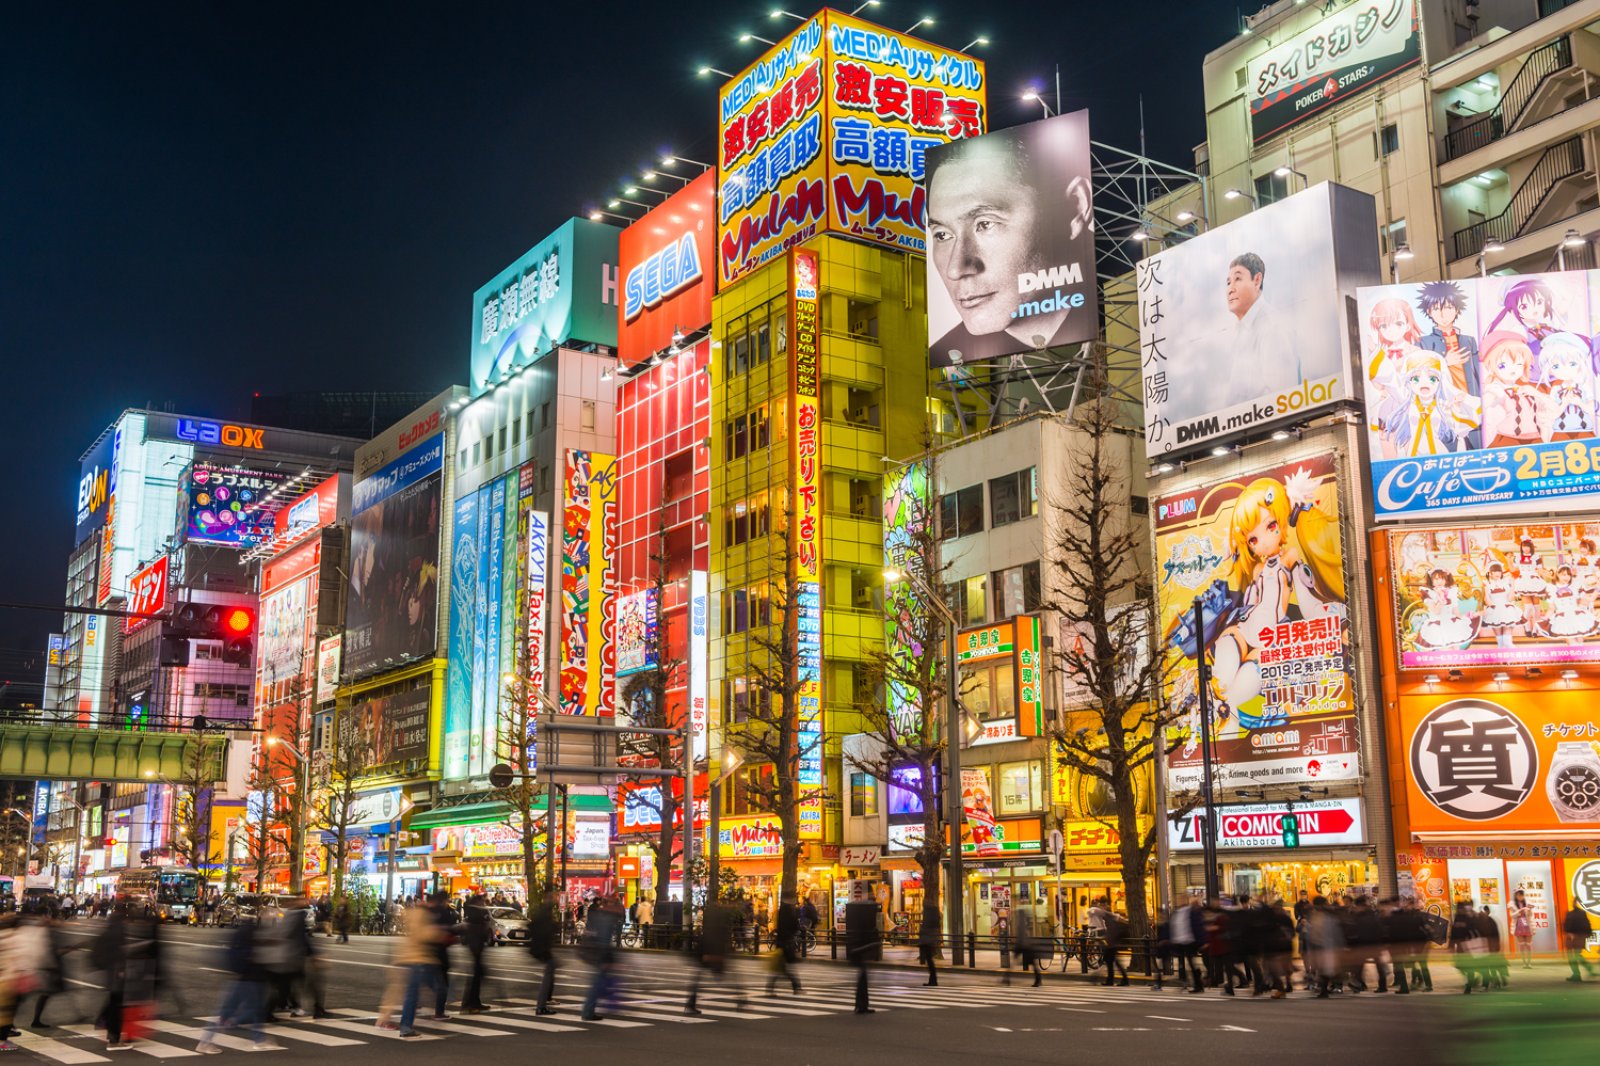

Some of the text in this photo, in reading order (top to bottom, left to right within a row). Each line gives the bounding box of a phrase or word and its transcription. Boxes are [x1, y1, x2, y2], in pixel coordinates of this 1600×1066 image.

[832, 25, 980, 90] MEDIAリサイクル
[1257, 0, 1405, 95] メイドカジノ
[723, 19, 820, 122] MEDIAリサイクル
[1295, 89, 1324, 111] POKER
[1338, 65, 1368, 89] STARS
[723, 61, 820, 168] 激安販売
[834, 62, 980, 138] 激安販売
[722, 113, 819, 222] 高額買取
[833, 118, 925, 179] 高額買
[834, 175, 925, 226] Mul
[720, 179, 825, 280] Mulan
[851, 222, 897, 242] ムーラン
[624, 231, 703, 322] SEGA
[731, 257, 760, 281] ムーラン
[760, 243, 783, 263] AKIBA
[1017, 262, 1084, 294] DMM
[480, 253, 560, 345] 廣瀬無線
[797, 301, 816, 312] DVD
[1010, 290, 1085, 319] .make
[800, 333, 813, 343] CD
[1138, 257, 1173, 453] 次は太陽か。
[797, 353, 816, 364] アニメ
[1276, 377, 1338, 415] solar
[1377, 461, 1461, 511] Café
[1425, 491, 1514, 507] 365 DAYS ANNIVERSARY
[1159, 497, 1197, 520] PLUM
[531, 514, 545, 574] AKKY
[529, 588, 544, 667] Tax-free
[968, 629, 1000, 649] 吉野家
[1258, 615, 1341, 648] 今月発売!!
[1021, 649, 1034, 703] 吉野家
[1261, 659, 1343, 680] 2019.2 発売予定
[693, 696, 705, 732] 3号館
[1542, 722, 1600, 736] チケット
[1251, 730, 1300, 748] amiami
[1250, 767, 1270, 780] goods
[1272, 765, 1284, 776] and
[1286, 765, 1304, 775] more
[1427, 716, 1527, 805] 質
[35, 787, 49, 816] AKIBA
[624, 786, 677, 827] SEG
[731, 820, 781, 854] Mulan
[1223, 838, 1277, 847] Akihabara
[845, 850, 877, 864] ラーメン
